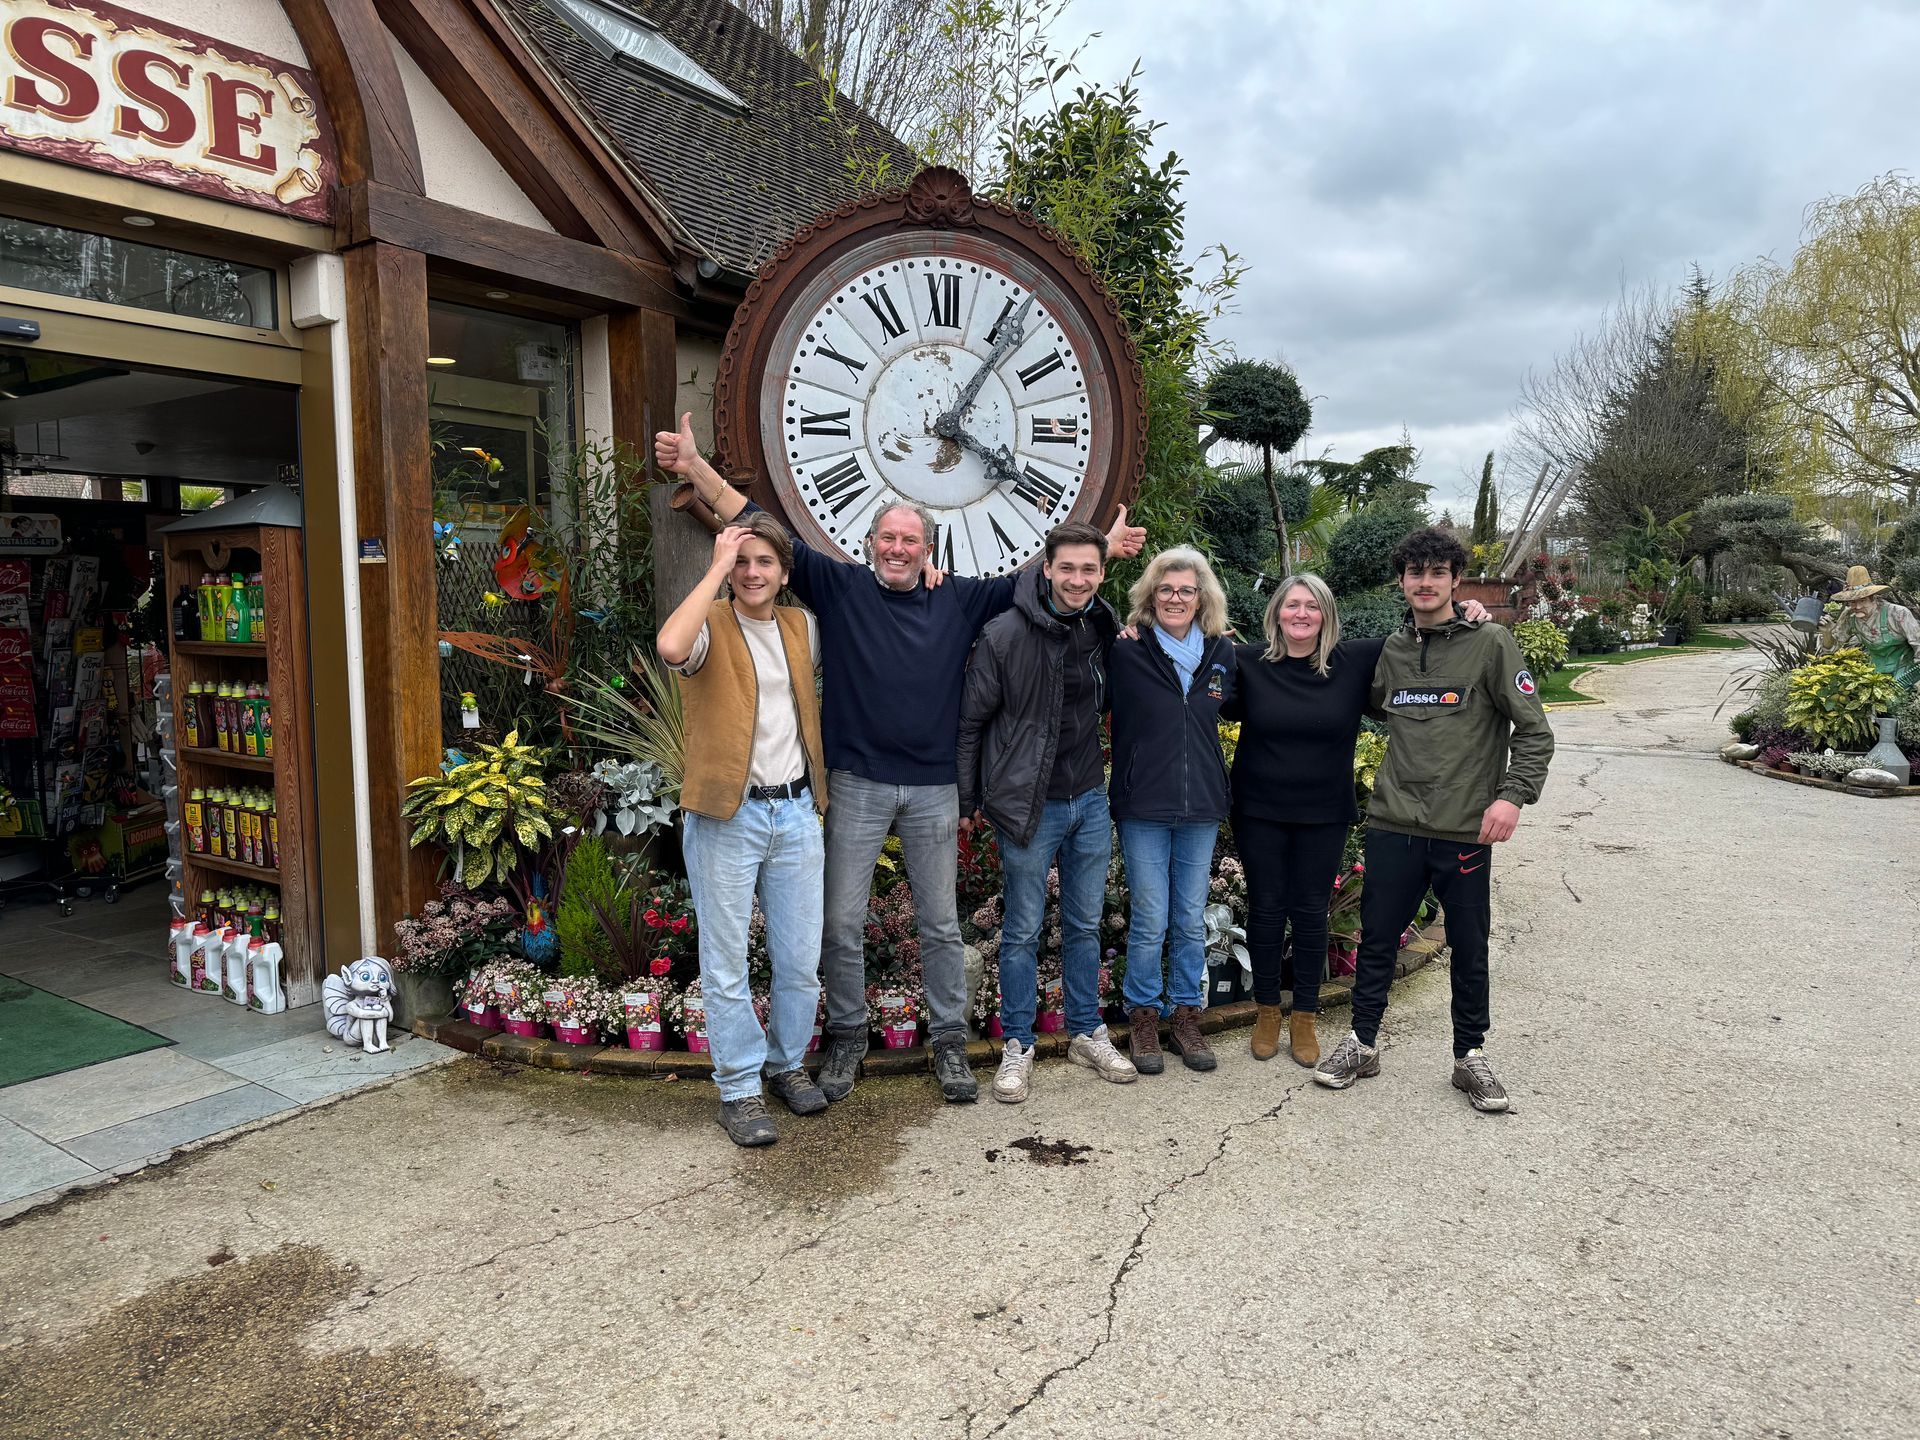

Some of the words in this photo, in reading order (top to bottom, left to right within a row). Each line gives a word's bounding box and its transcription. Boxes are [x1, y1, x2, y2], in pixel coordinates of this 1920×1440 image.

[859, 283, 909, 345] XI
[923, 273, 963, 329] XII
[814, 334, 868, 384] X
[1016, 348, 1065, 391] II
[800, 405, 851, 440] IX
[1031, 414, 1078, 447] III
[811, 453, 871, 519] VIII
[987, 512, 1019, 559] V
[1393, 690, 1438, 705] ellesse
